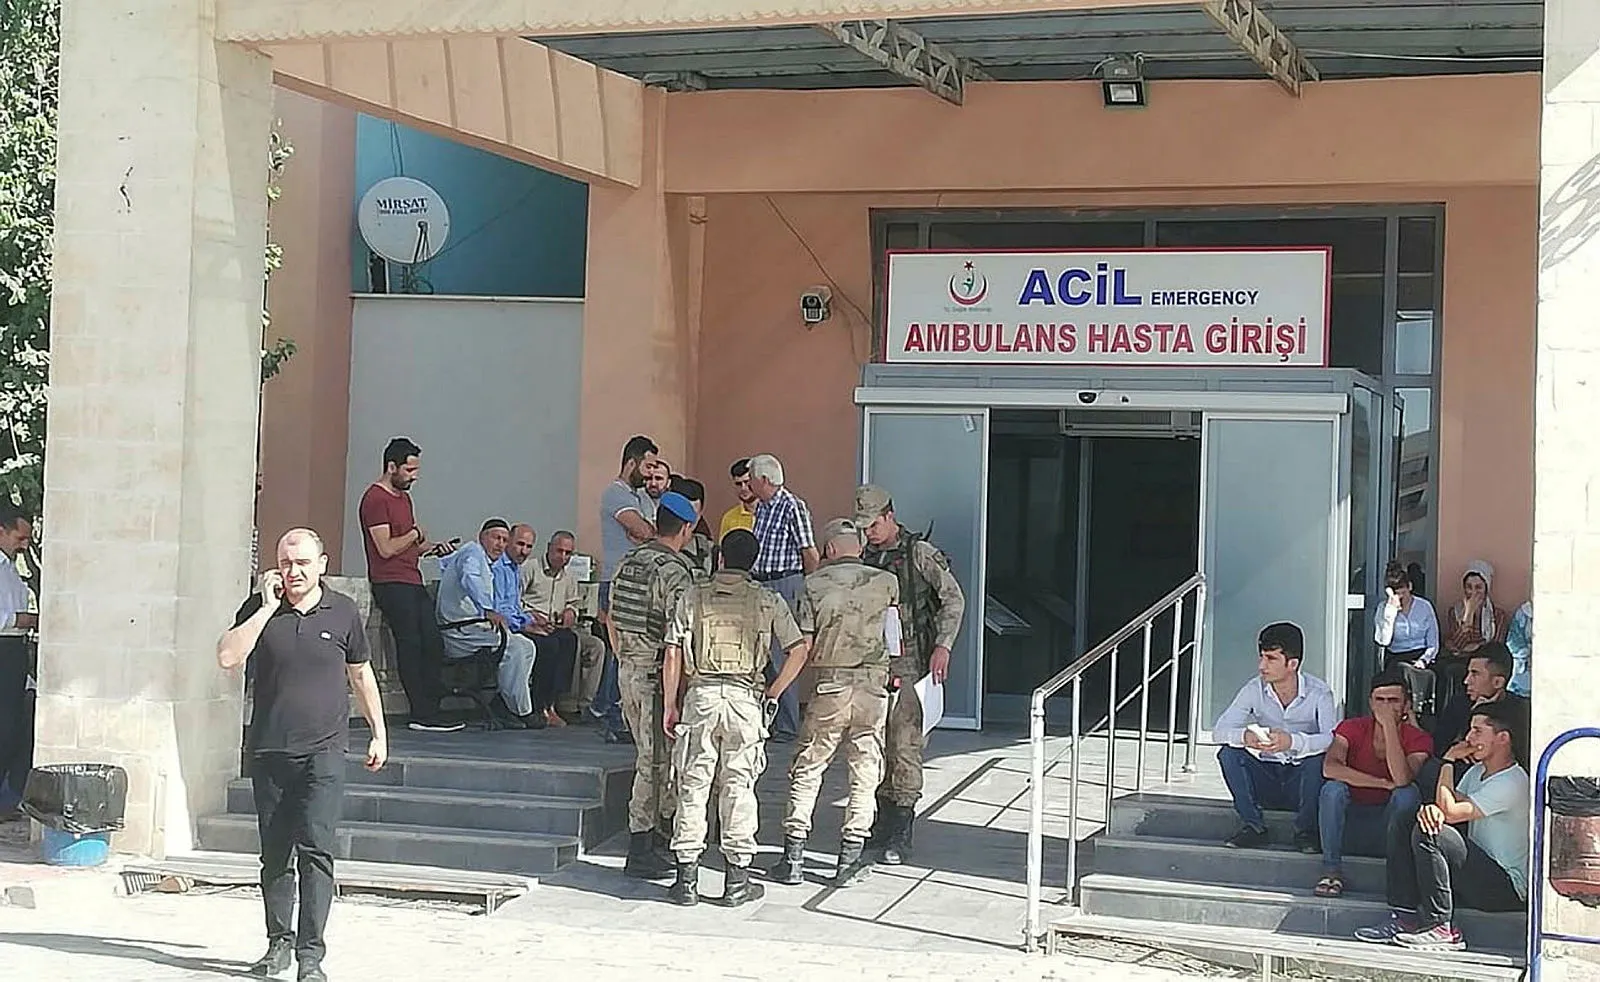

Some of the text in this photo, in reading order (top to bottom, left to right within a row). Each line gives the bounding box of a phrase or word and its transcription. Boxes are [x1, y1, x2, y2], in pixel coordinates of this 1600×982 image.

[1018, 263, 1259, 306] ACİL EMERGENCY
[904, 316, 1307, 362] AMBULANS HASTA GİRİŞİ
